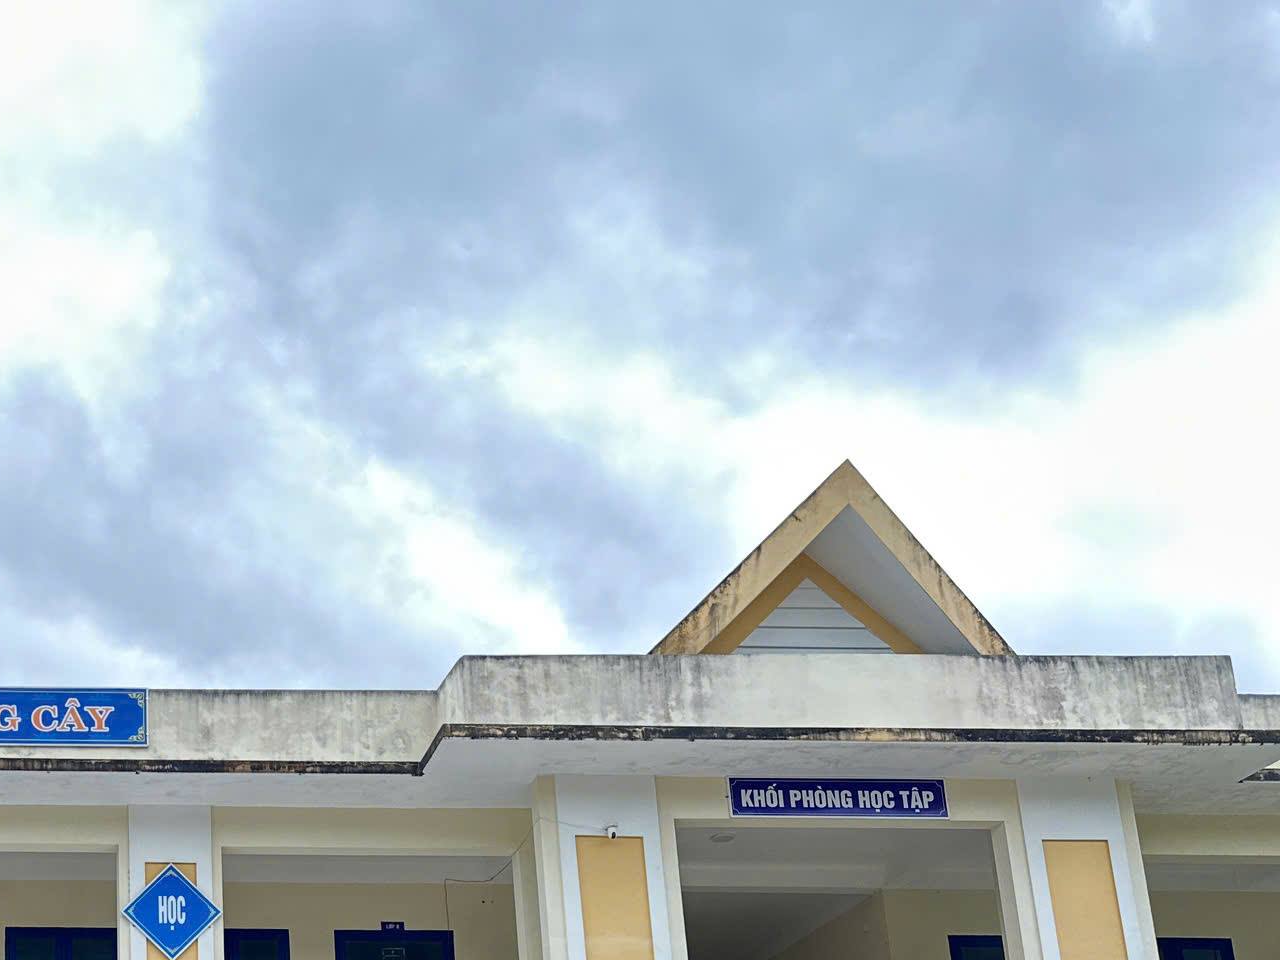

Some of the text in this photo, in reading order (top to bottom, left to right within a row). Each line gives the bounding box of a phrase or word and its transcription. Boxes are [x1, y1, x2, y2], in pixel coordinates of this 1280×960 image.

[31, 697, 116, 732] CÂY
[740, 783, 934, 812] KHỐI PHÒNG HỌC TẬP
[158, 895, 186, 930] HỌC
